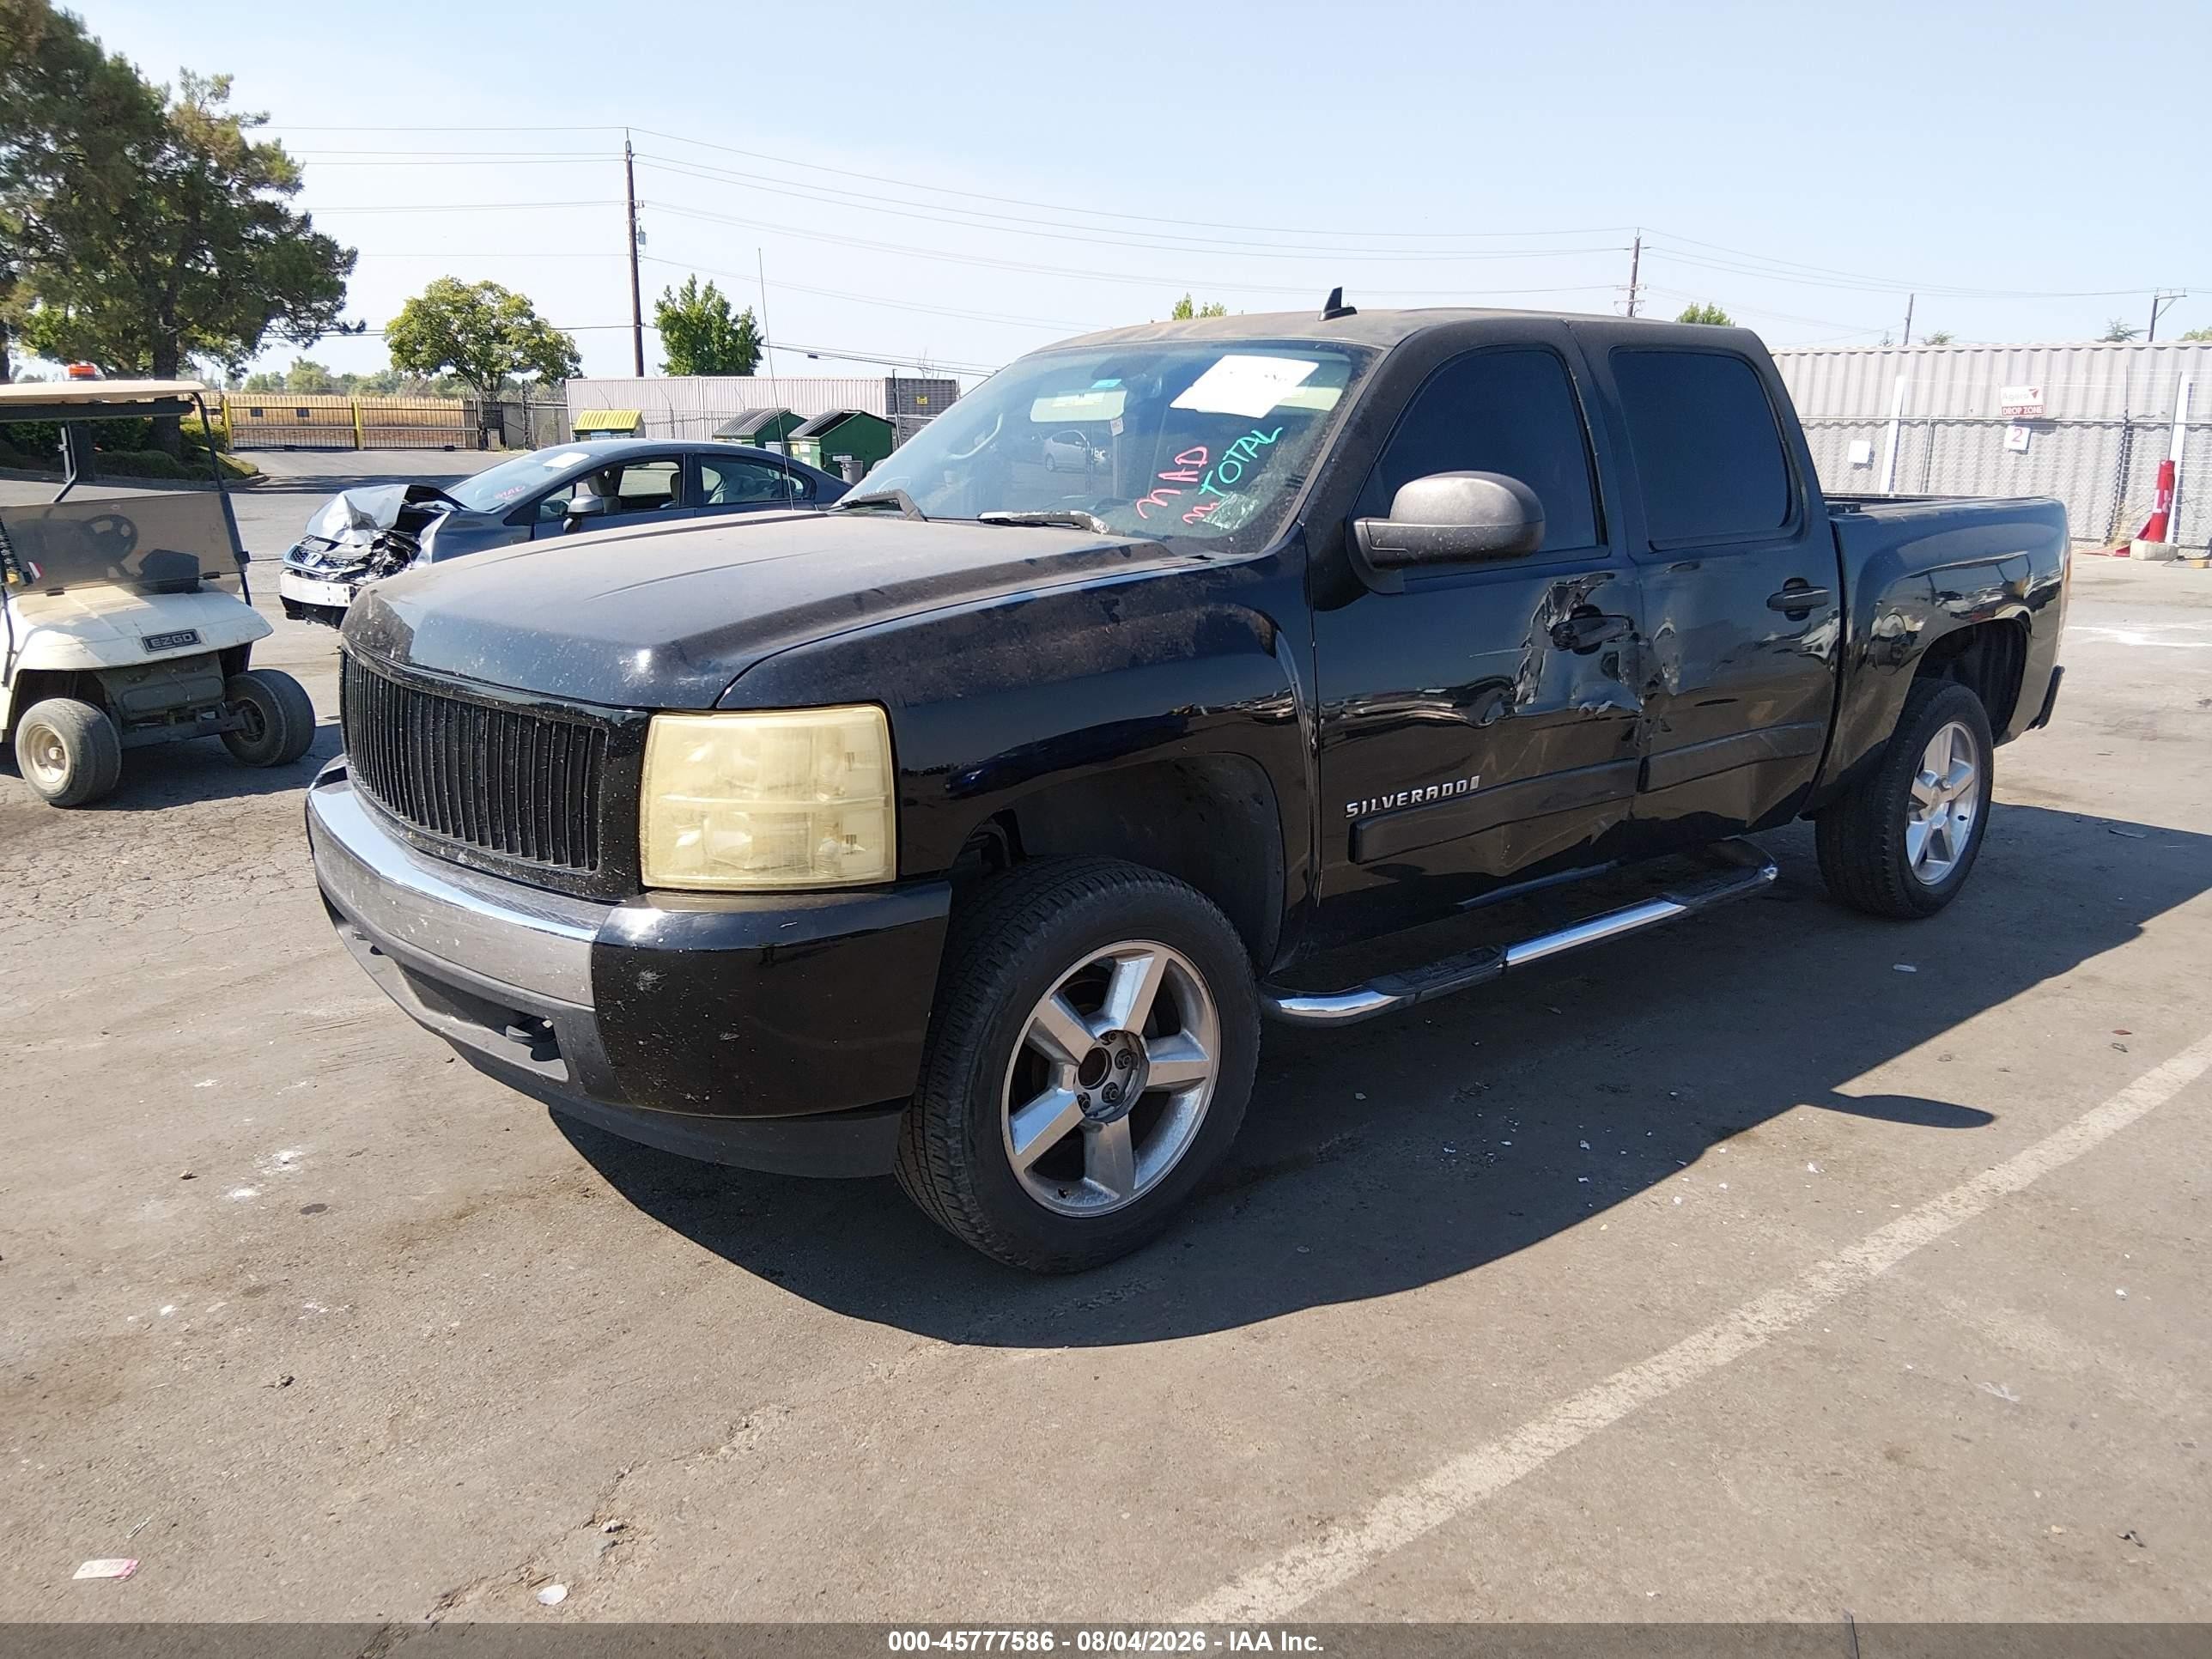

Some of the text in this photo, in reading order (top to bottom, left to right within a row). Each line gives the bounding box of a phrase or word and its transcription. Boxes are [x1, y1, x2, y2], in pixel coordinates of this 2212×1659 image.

[2023, 405, 2043, 414] ZONE
[2012, 428, 2023, 442] 2
[1198, 427, 1283, 496] TOTAL
[1346, 779, 1468, 818] SILVERADO
